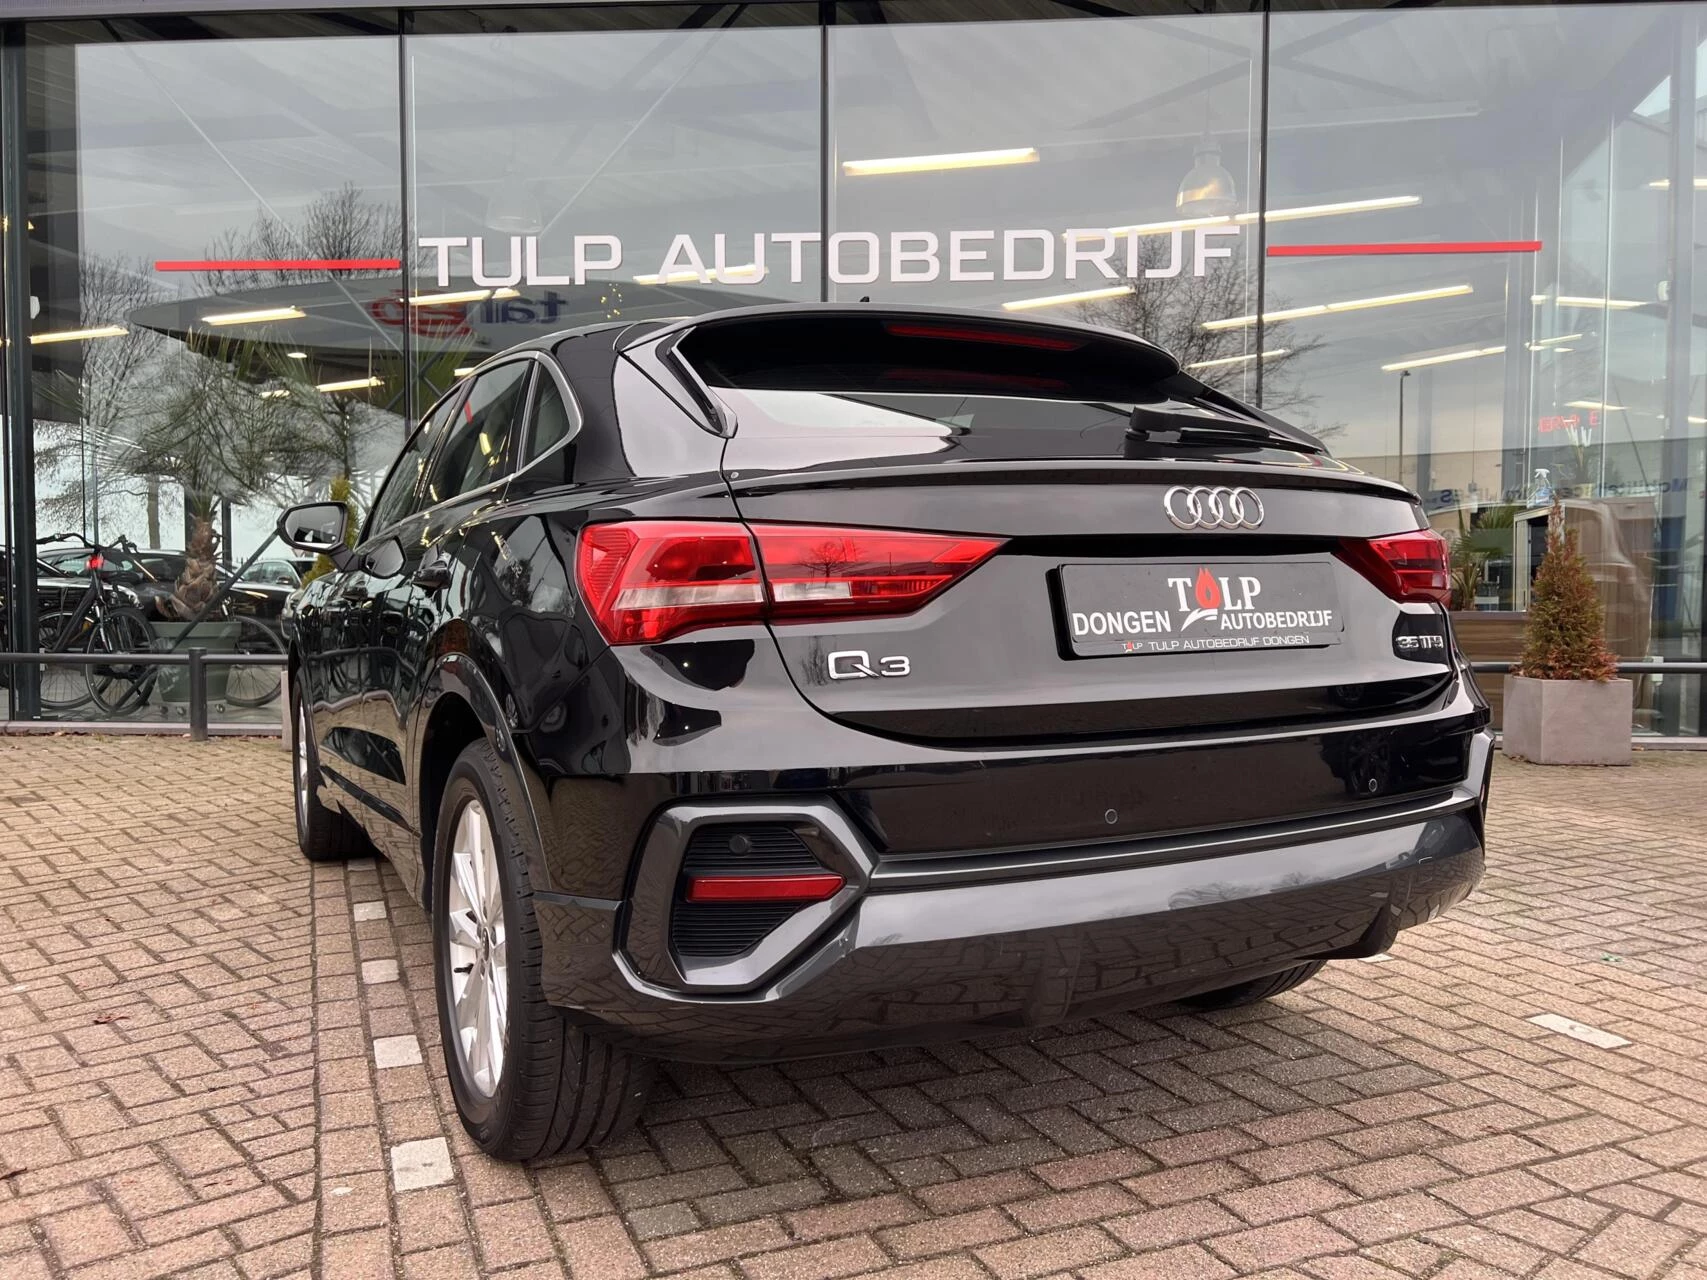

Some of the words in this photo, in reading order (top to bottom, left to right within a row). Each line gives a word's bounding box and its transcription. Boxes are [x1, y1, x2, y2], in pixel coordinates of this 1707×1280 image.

[418, 235, 623, 287] TULP
[656, 225, 1240, 285] AUTOBEDRIJF
[1073, 611, 1171, 635] DONGEN
[1220, 610, 1333, 630] AUTOBEDRIJF
[1150, 639, 1179, 651] TULP
[1183, 637, 1259, 650] AUTOBEDRIJF
[1263, 635, 1309, 646] DONGEN
[828, 650, 910, 679] Q3
